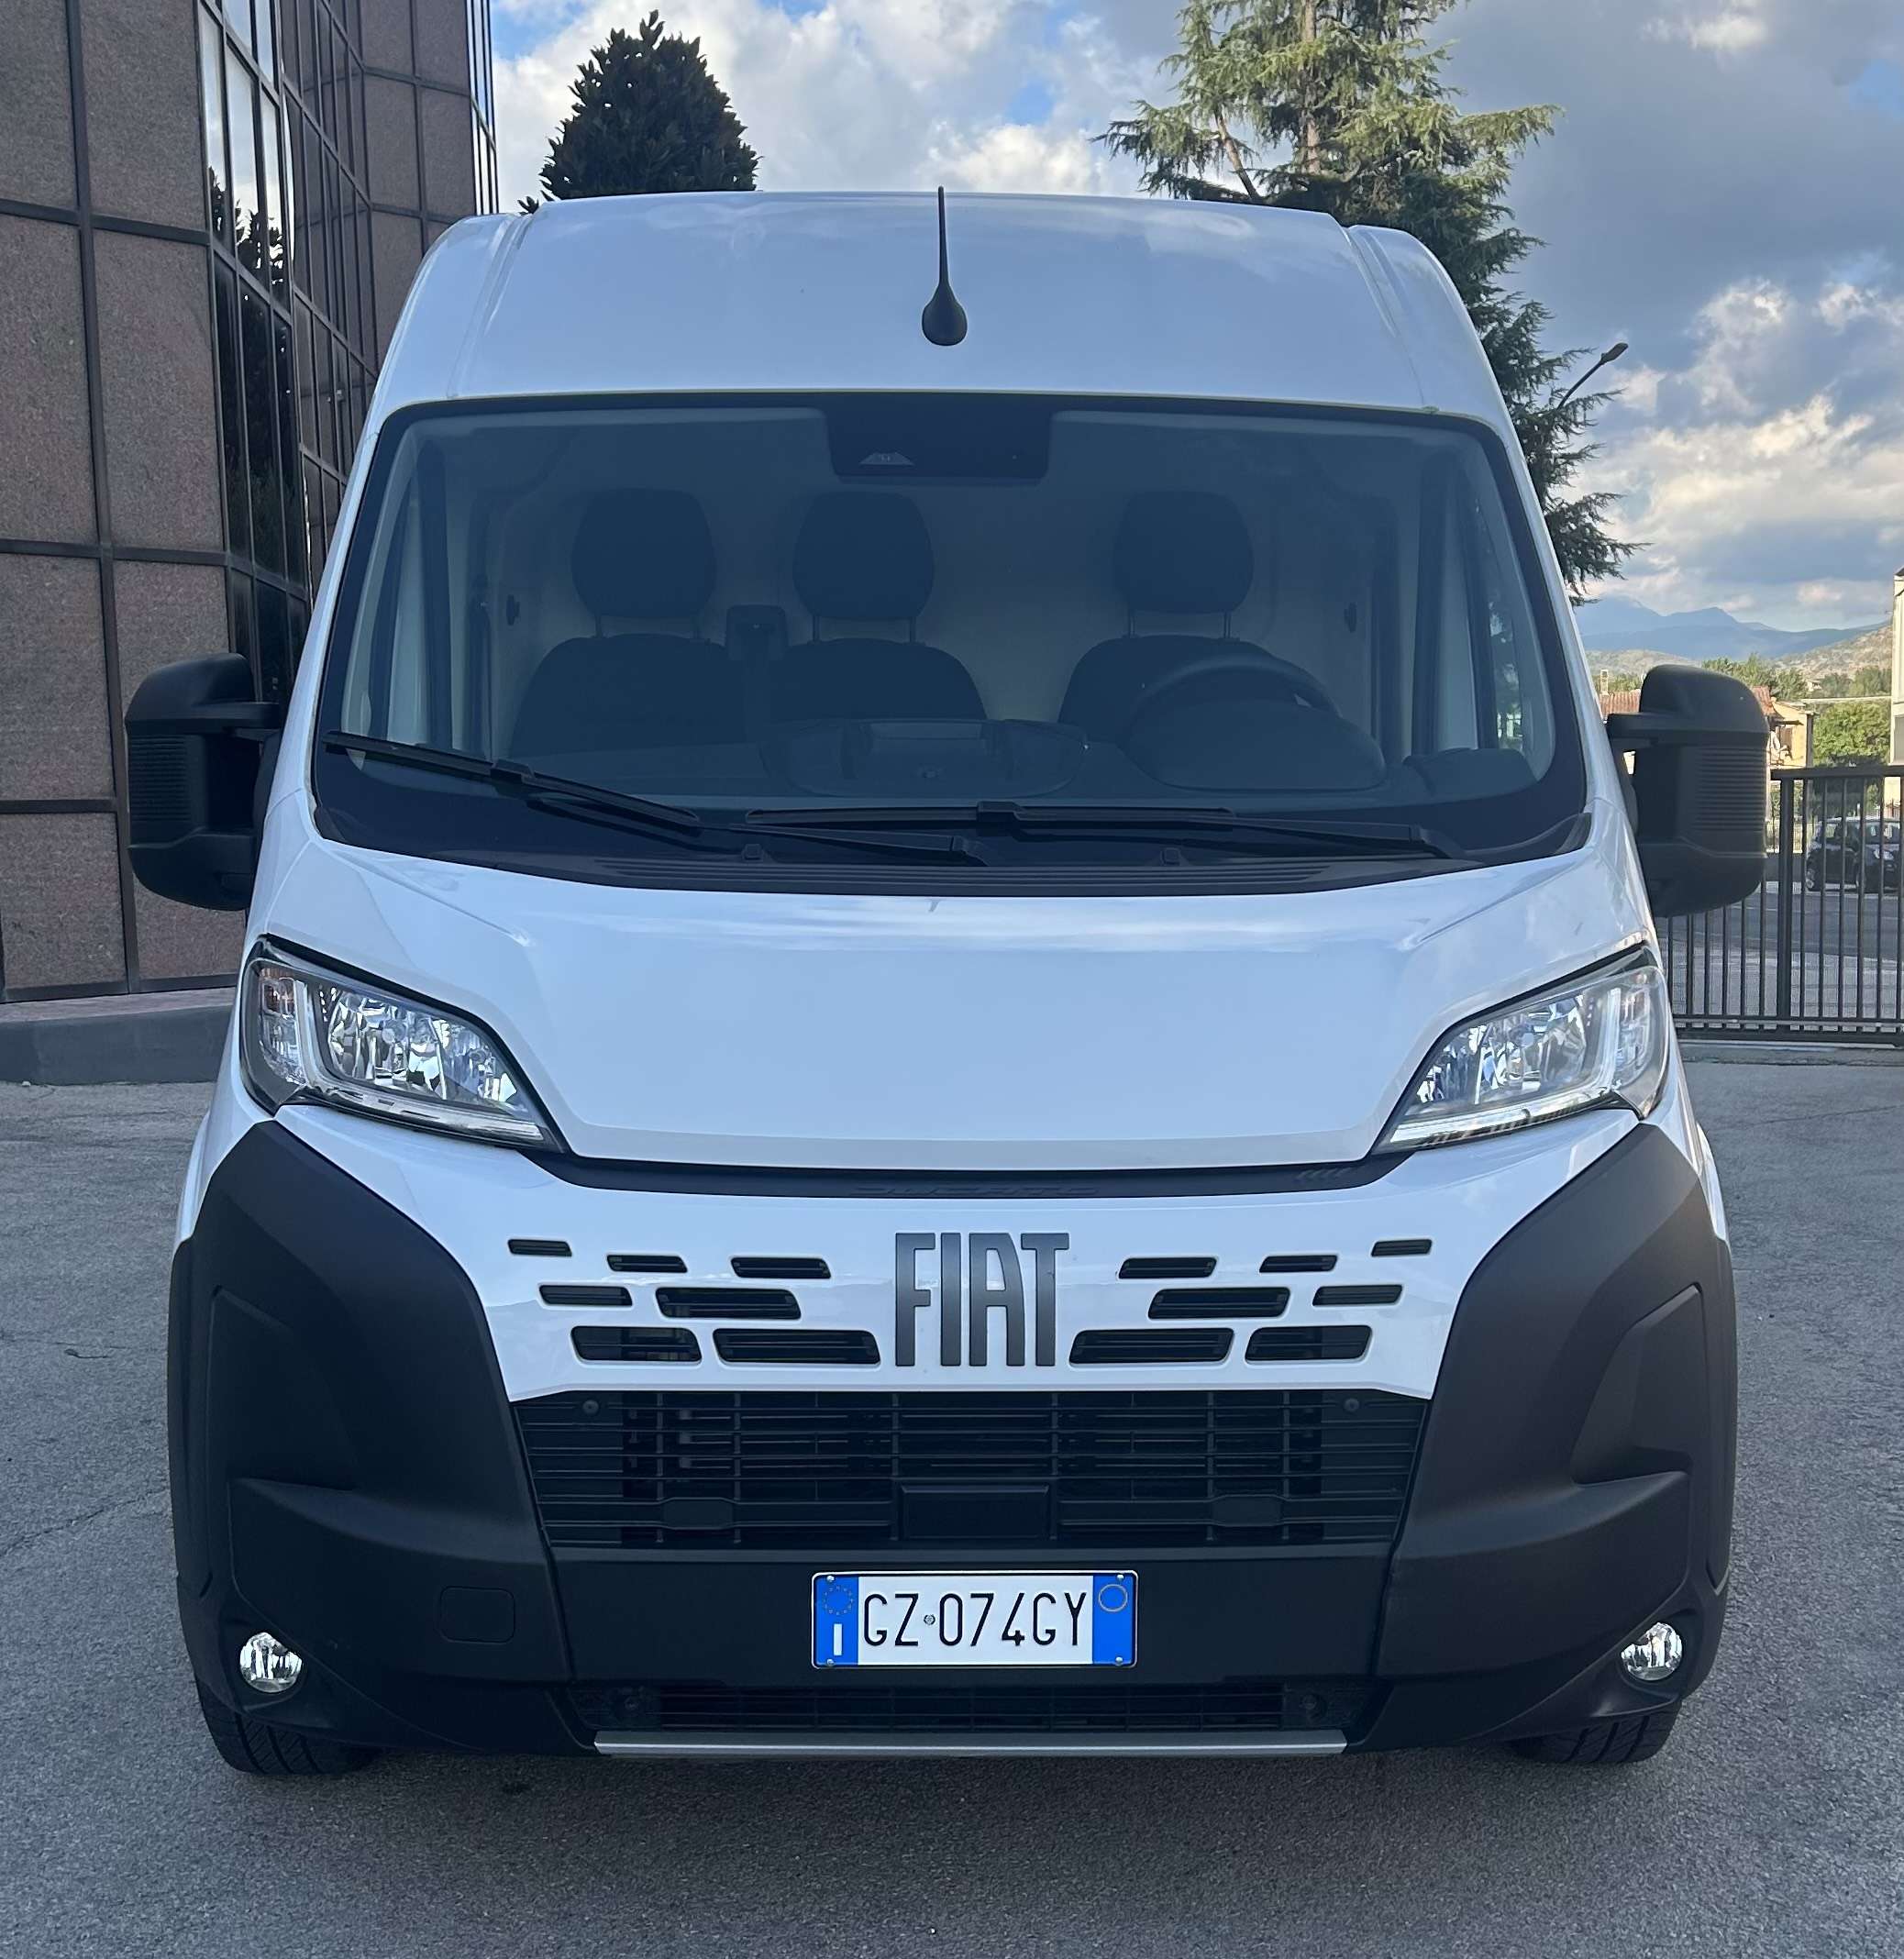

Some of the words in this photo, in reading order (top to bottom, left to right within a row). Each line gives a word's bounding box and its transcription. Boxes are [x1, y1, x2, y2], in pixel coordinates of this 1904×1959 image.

[895, 1232, 1069, 1367] FIAT
[834, 1623, 842, 1655] I
[864, 1592, 919, 1647] GZ
[939, 1592, 1087, 1646] 074GY
